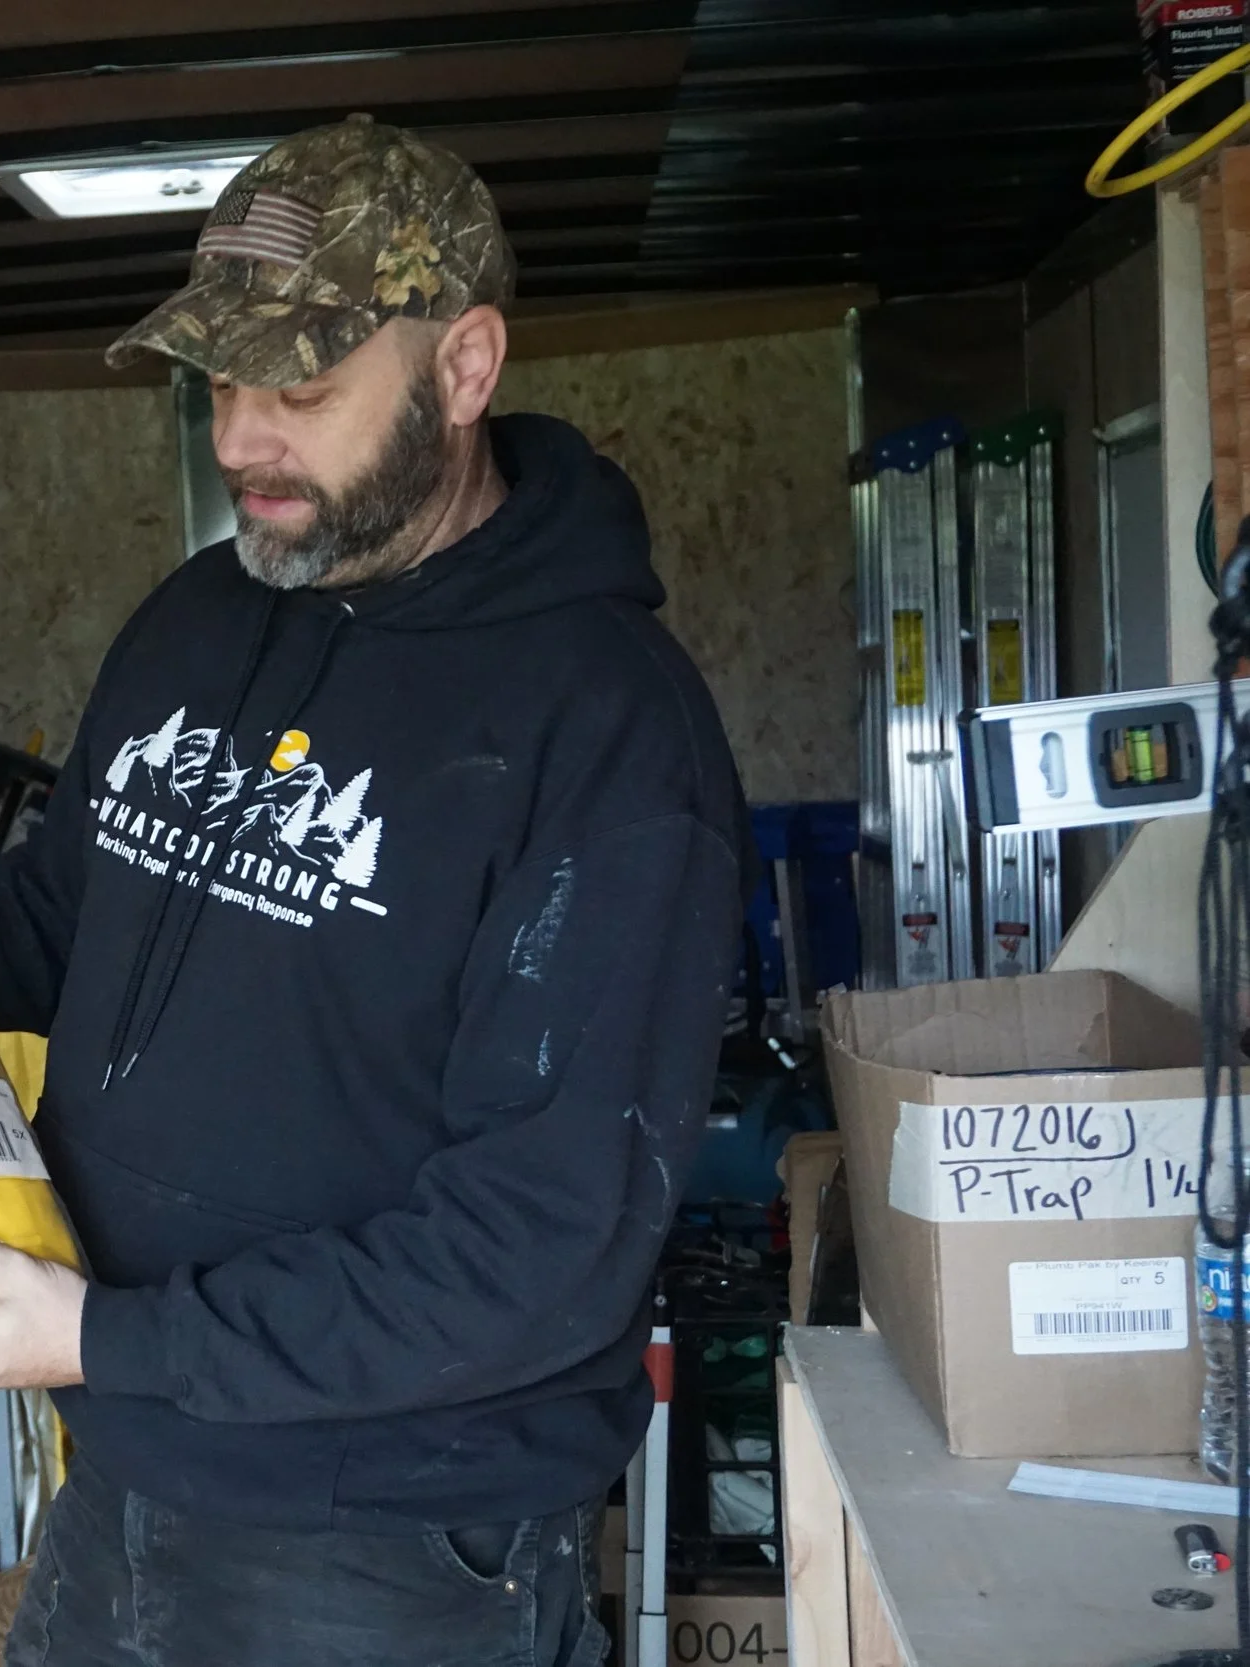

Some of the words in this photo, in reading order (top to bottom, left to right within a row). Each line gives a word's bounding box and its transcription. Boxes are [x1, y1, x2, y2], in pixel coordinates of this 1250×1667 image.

[1177, 5, 1233, 20] ROBERTS
[1171, 28, 1213, 39] Flooring
[96, 830, 134, 865] Working
[256, 894, 313, 928] Response
[11, 1128, 28, 1141] 5X
[949, 1165, 1092, 1221] P-Trap
[1036, 1262, 1074, 1270] Plumb
[1078, 1261, 1101, 1269] Pak
[1106, 1260, 1119, 1270] by
[1120, 1276, 1141, 1285] QTY
[1154, 1271, 1165, 1285] 5
